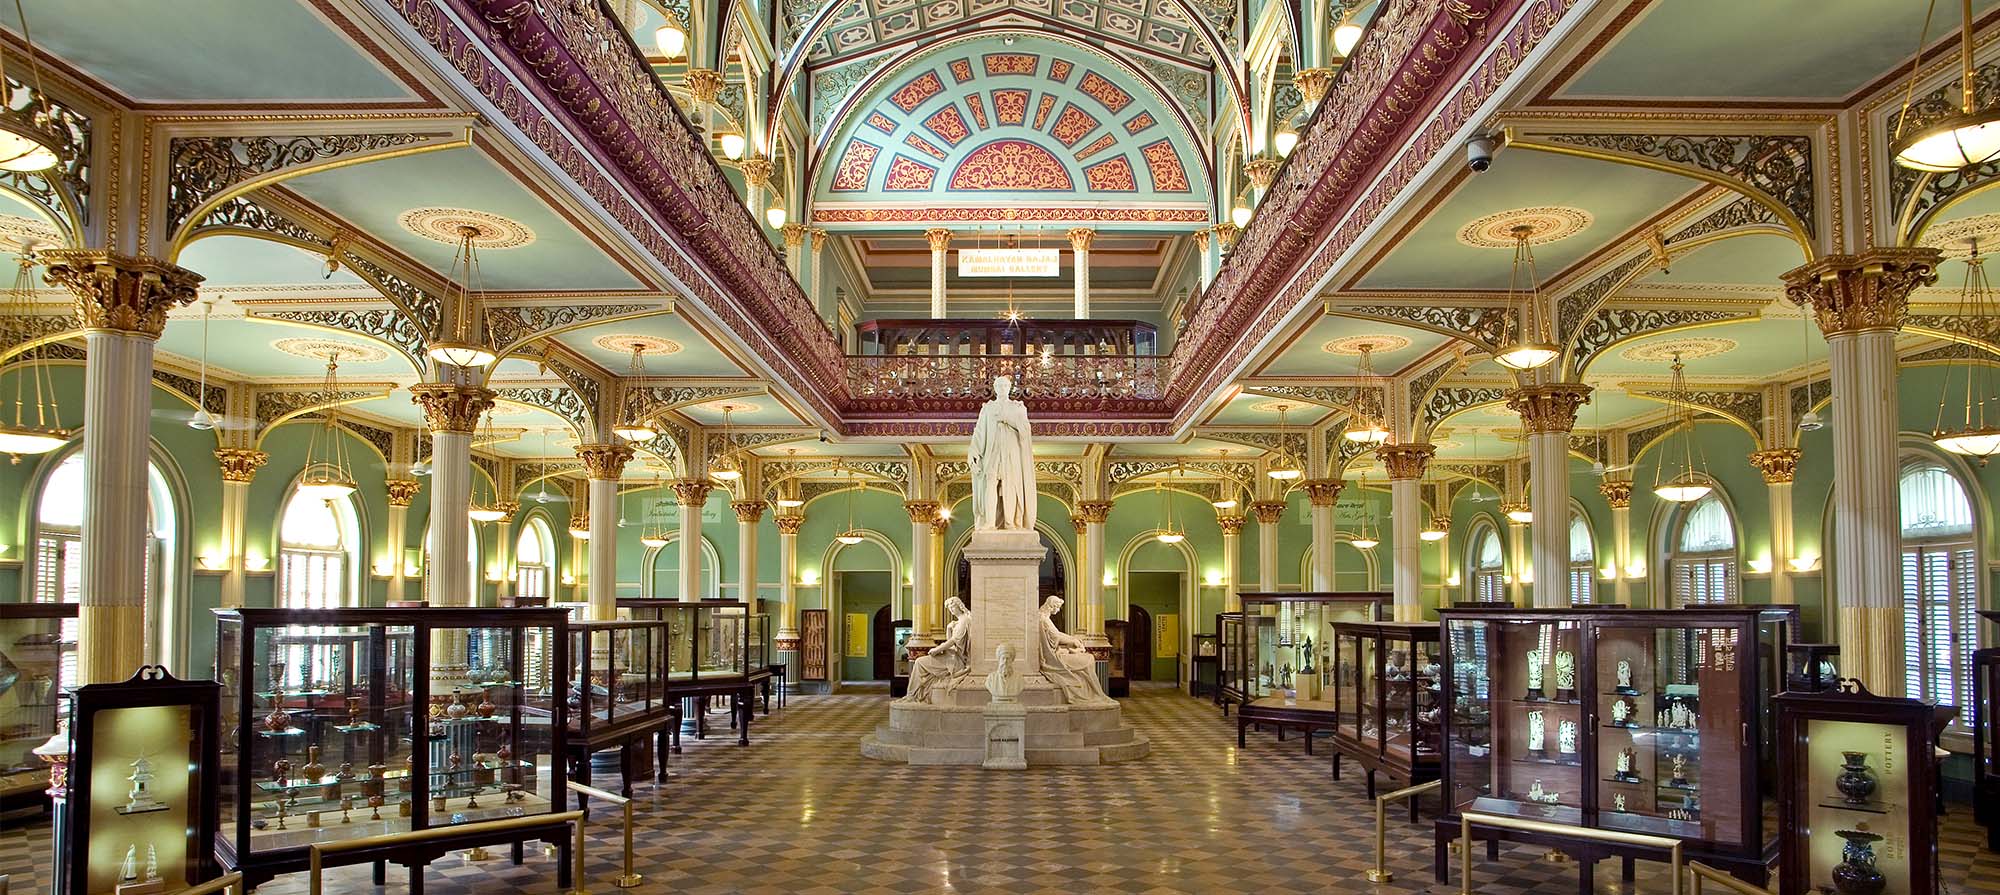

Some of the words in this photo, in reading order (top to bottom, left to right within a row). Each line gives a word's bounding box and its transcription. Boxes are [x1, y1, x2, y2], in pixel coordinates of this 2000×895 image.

[1009, 265, 1049, 273] GALLERY
[1714, 640, 1724, 672] IVOR
[1884, 731, 1893, 775] POTTERY
